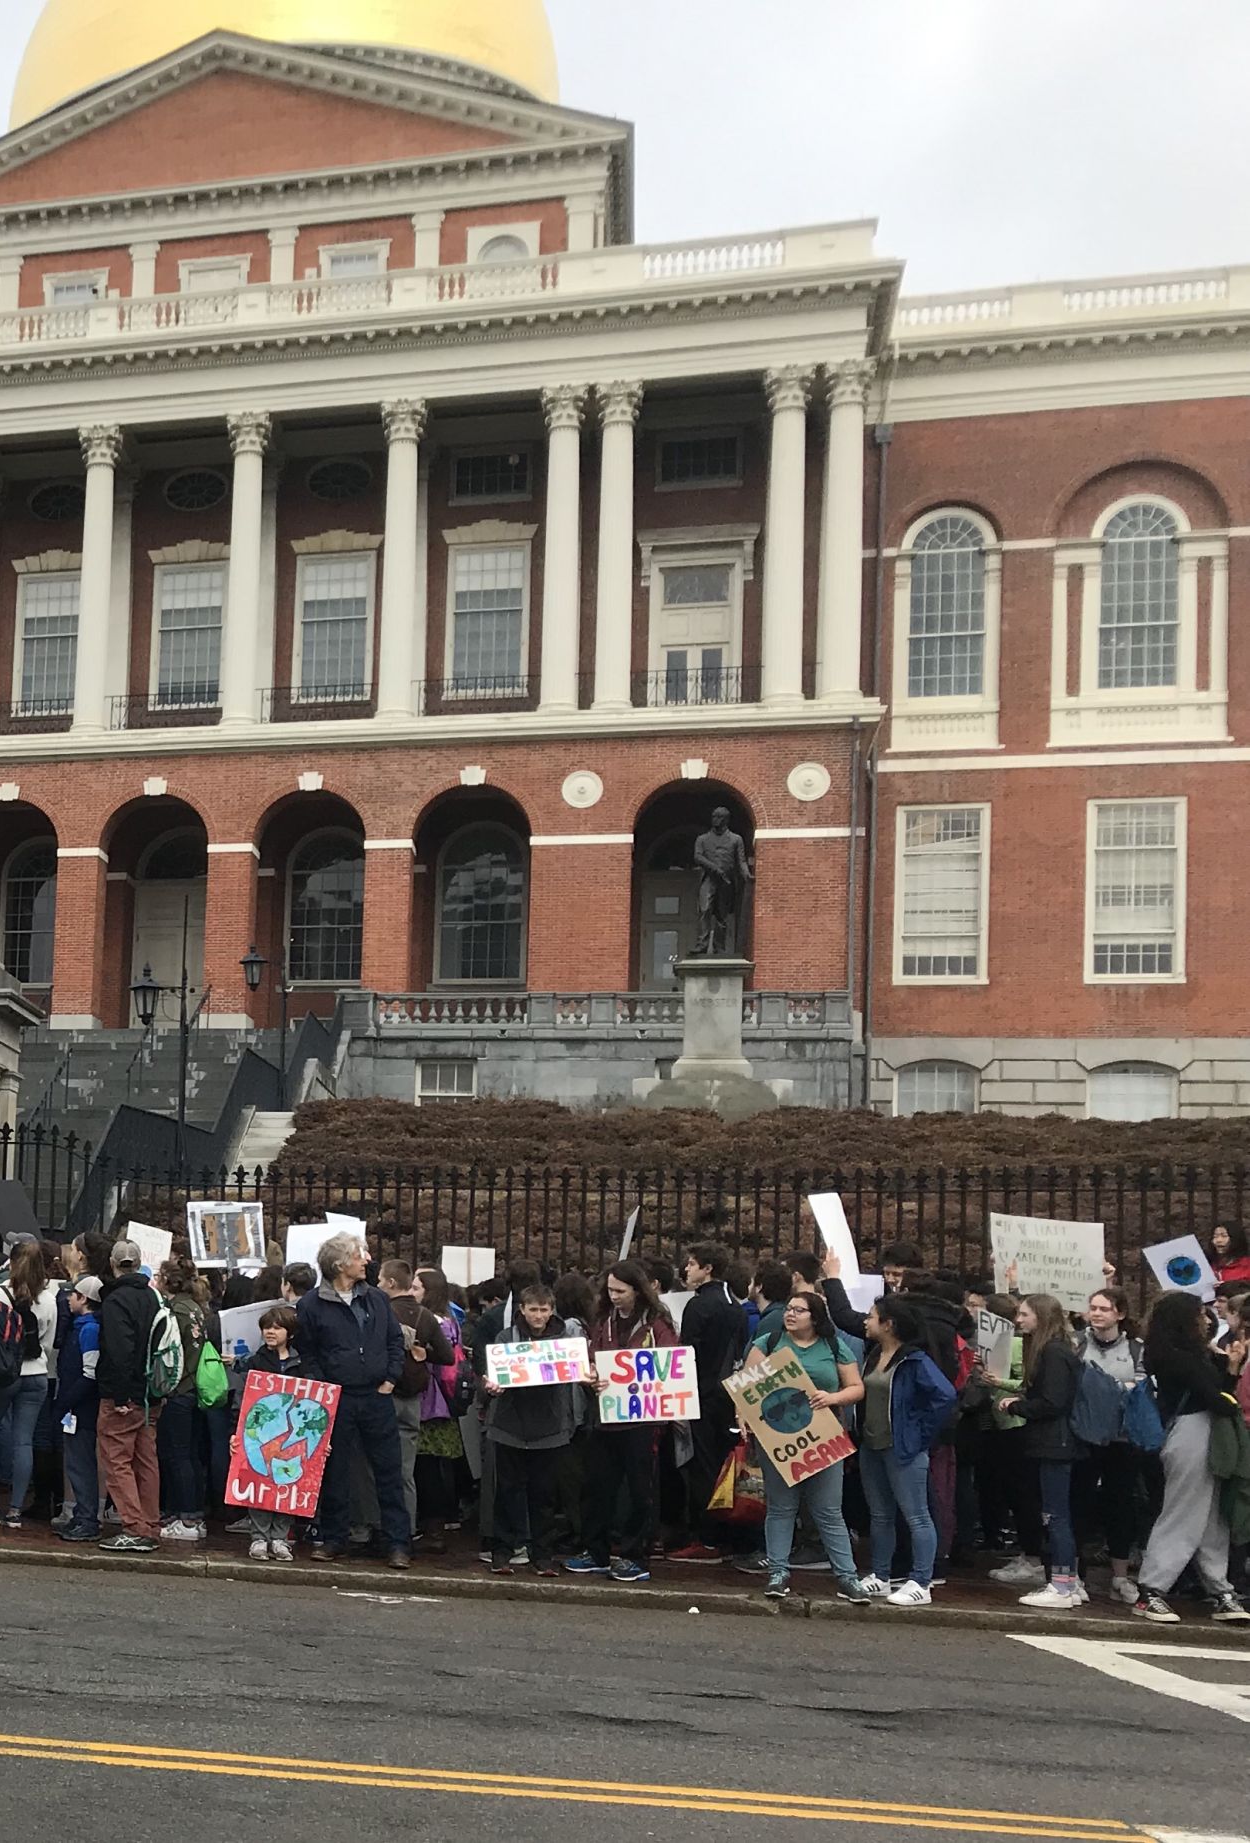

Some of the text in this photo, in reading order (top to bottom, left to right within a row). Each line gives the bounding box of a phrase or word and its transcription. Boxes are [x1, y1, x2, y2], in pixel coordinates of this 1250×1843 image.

[249, 1373, 275, 1392] IS
[610, 1349, 686, 1385] SAVE
[726, 1358, 778, 1393] MAKE
[742, 1360, 804, 1406] EARTH
[627, 1380, 664, 1395] OUR
[602, 1391, 693, 1422] PLANET
[773, 1430, 821, 1463] COOL
[790, 1430, 857, 1482] AGAIN
[231, 1478, 271, 1504] ur
